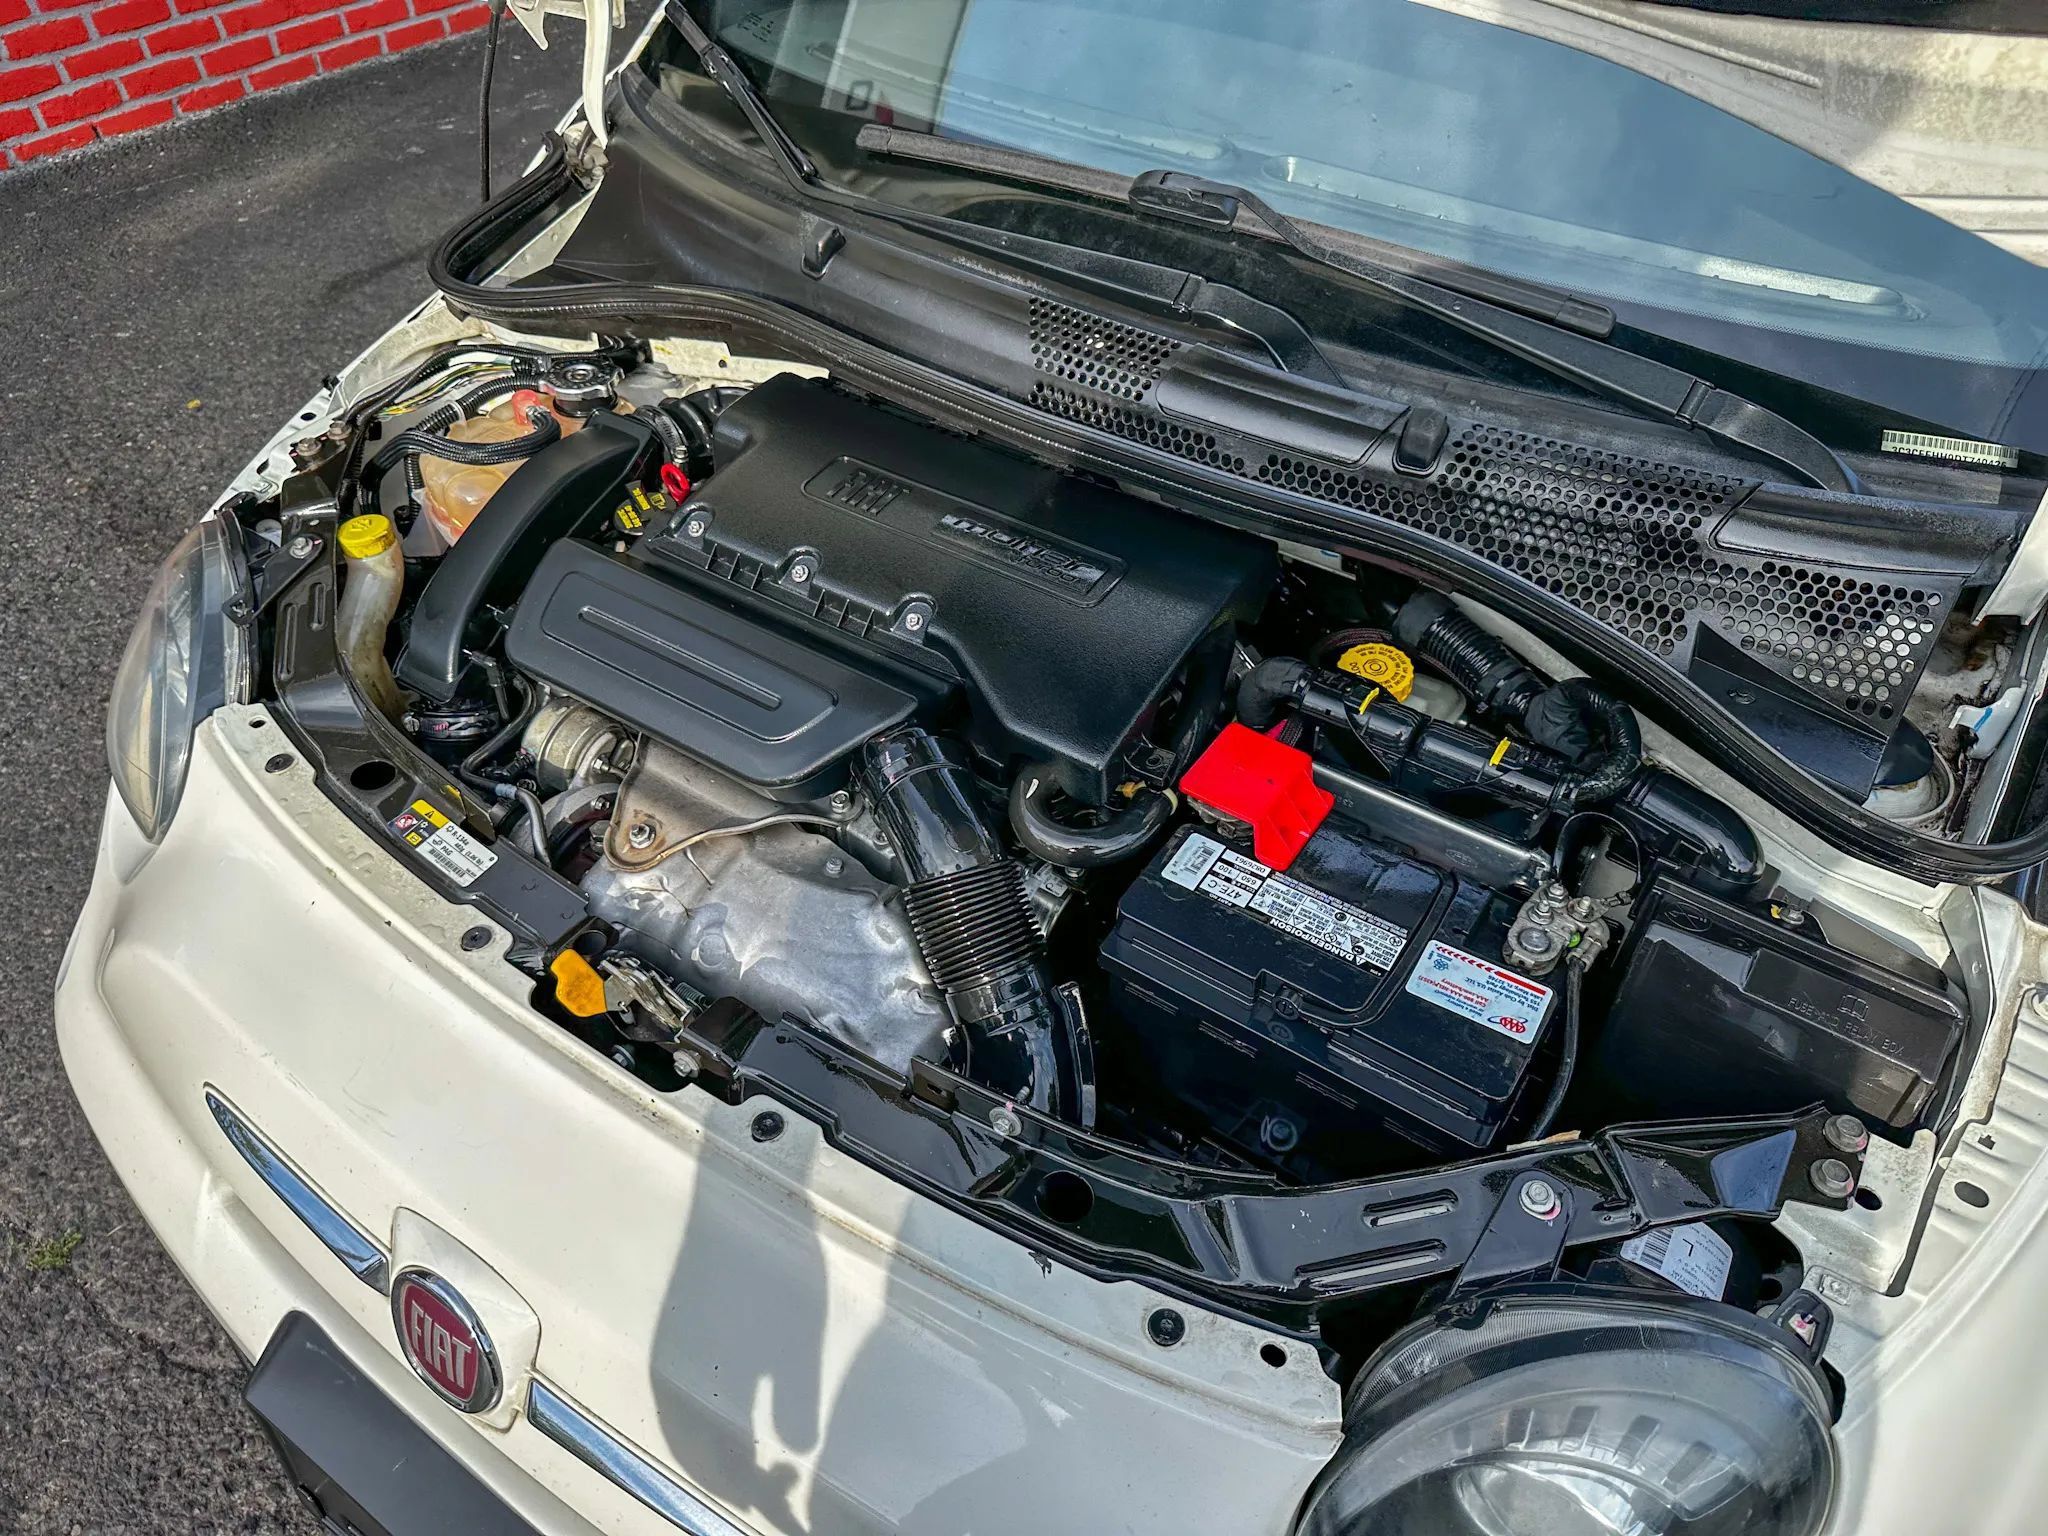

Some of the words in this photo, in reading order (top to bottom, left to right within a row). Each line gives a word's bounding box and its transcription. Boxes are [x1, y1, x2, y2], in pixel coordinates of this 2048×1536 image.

[826, 467, 911, 516] FIAT
[451, 831, 470, 846] R-134a
[440, 845, 453, 856] PAG
[1217, 864, 1233, 874] 100
[1240, 874, 1257, 885] 650
[1217, 897, 1232, 905] PART
[1268, 917, 1354, 961] DANGER/POISON
[1485, 979, 1497, 987] Park
[1498, 984, 1529, 1001] Technology
[1503, 993, 1516, 1002] Club
[1529, 992, 1542, 1001] Lake
[1474, 999, 1486, 1007] Call
[1501, 1017, 1525, 1033] AAA
[1787, 997, 1815, 1016] FUSE
[1881, 1038, 1905, 1056] BOX
[1683, 1238, 1694, 1257] L
[410, 1299, 472, 1389] FIAT
